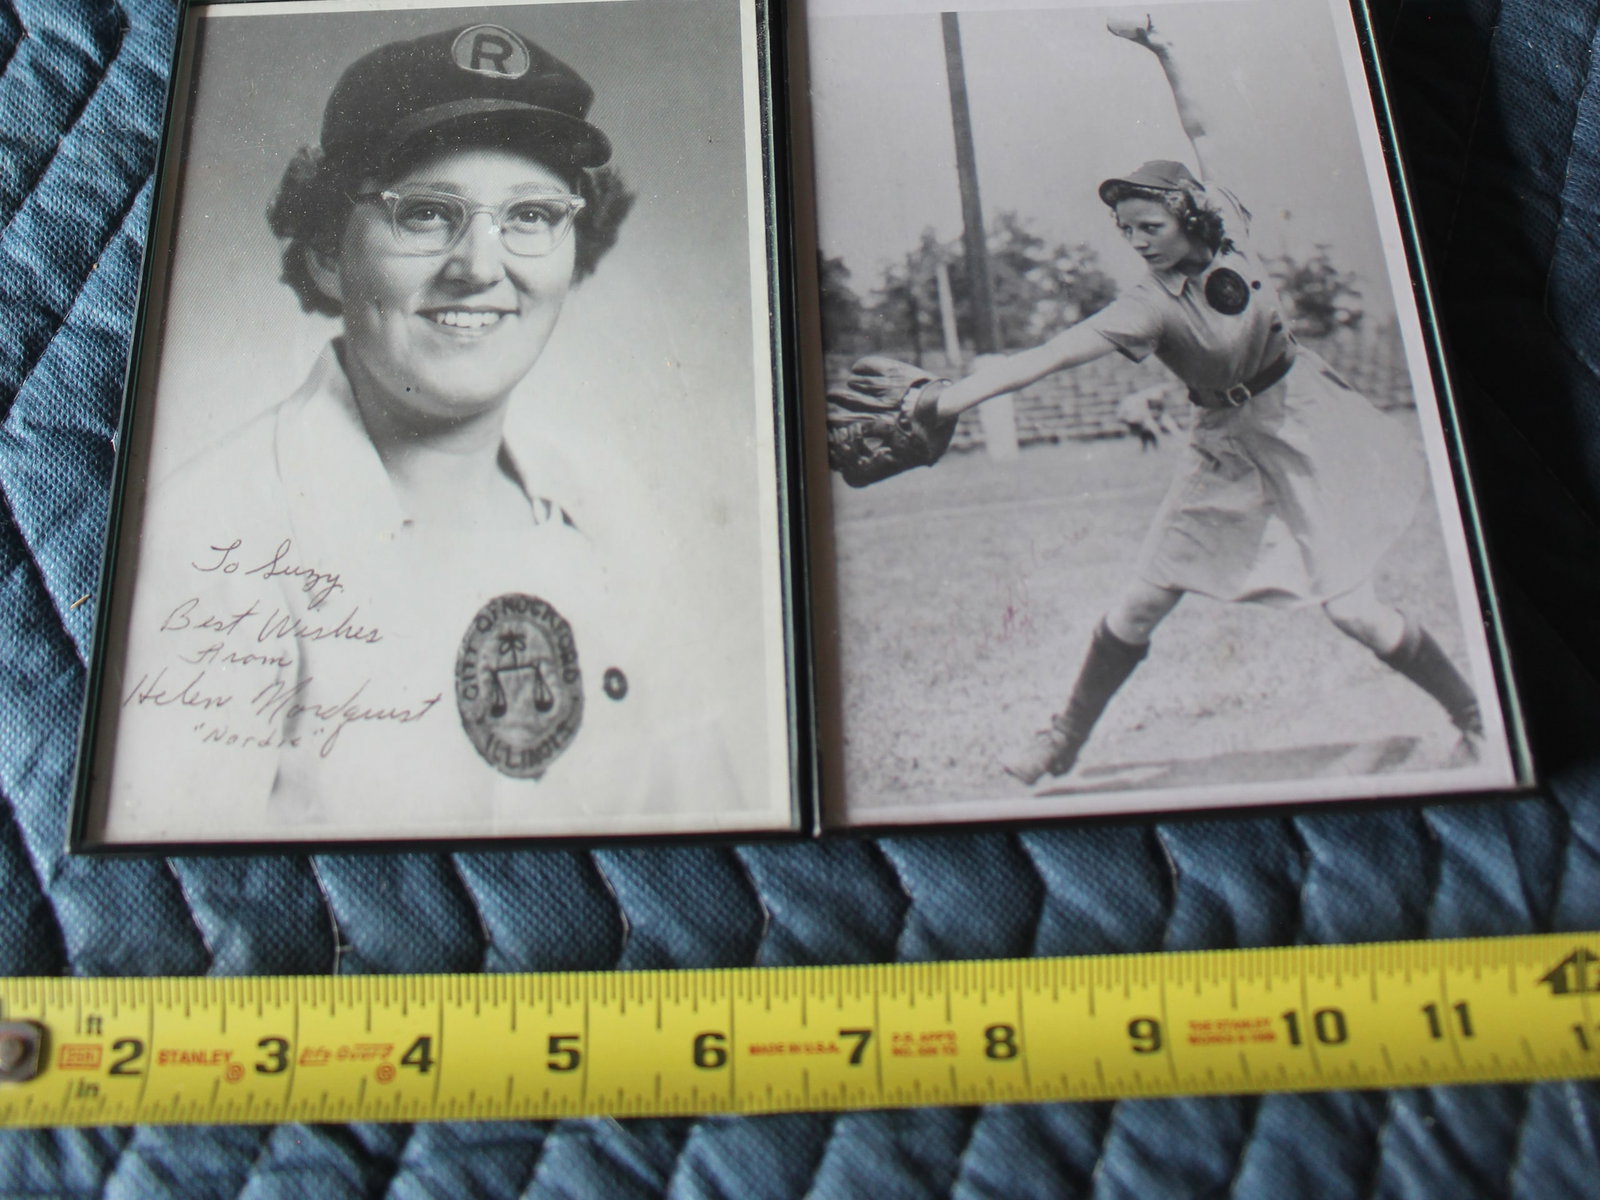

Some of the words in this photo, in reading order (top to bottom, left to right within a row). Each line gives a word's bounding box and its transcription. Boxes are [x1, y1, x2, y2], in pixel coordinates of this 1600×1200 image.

[470, 33, 513, 74] R
[192, 539, 242, 572] To
[160, 598, 260, 636] Best
[257, 606, 384, 643] Wishes
[122, 667, 234, 710] Helen
[1282, 1007, 1348, 1047] 10
[1421, 1001, 1476, 1039] 11
[108, 1038, 145, 1076] 2
[254, 1037, 291, 1075] 3
[400, 1036, 435, 1074] 4
[547, 1035, 581, 1072] 5
[693, 1032, 728, 1069] 6
[838, 1030, 874, 1066] 7
[983, 1023, 1018, 1061] 8
[1127, 1017, 1163, 1053] 9
